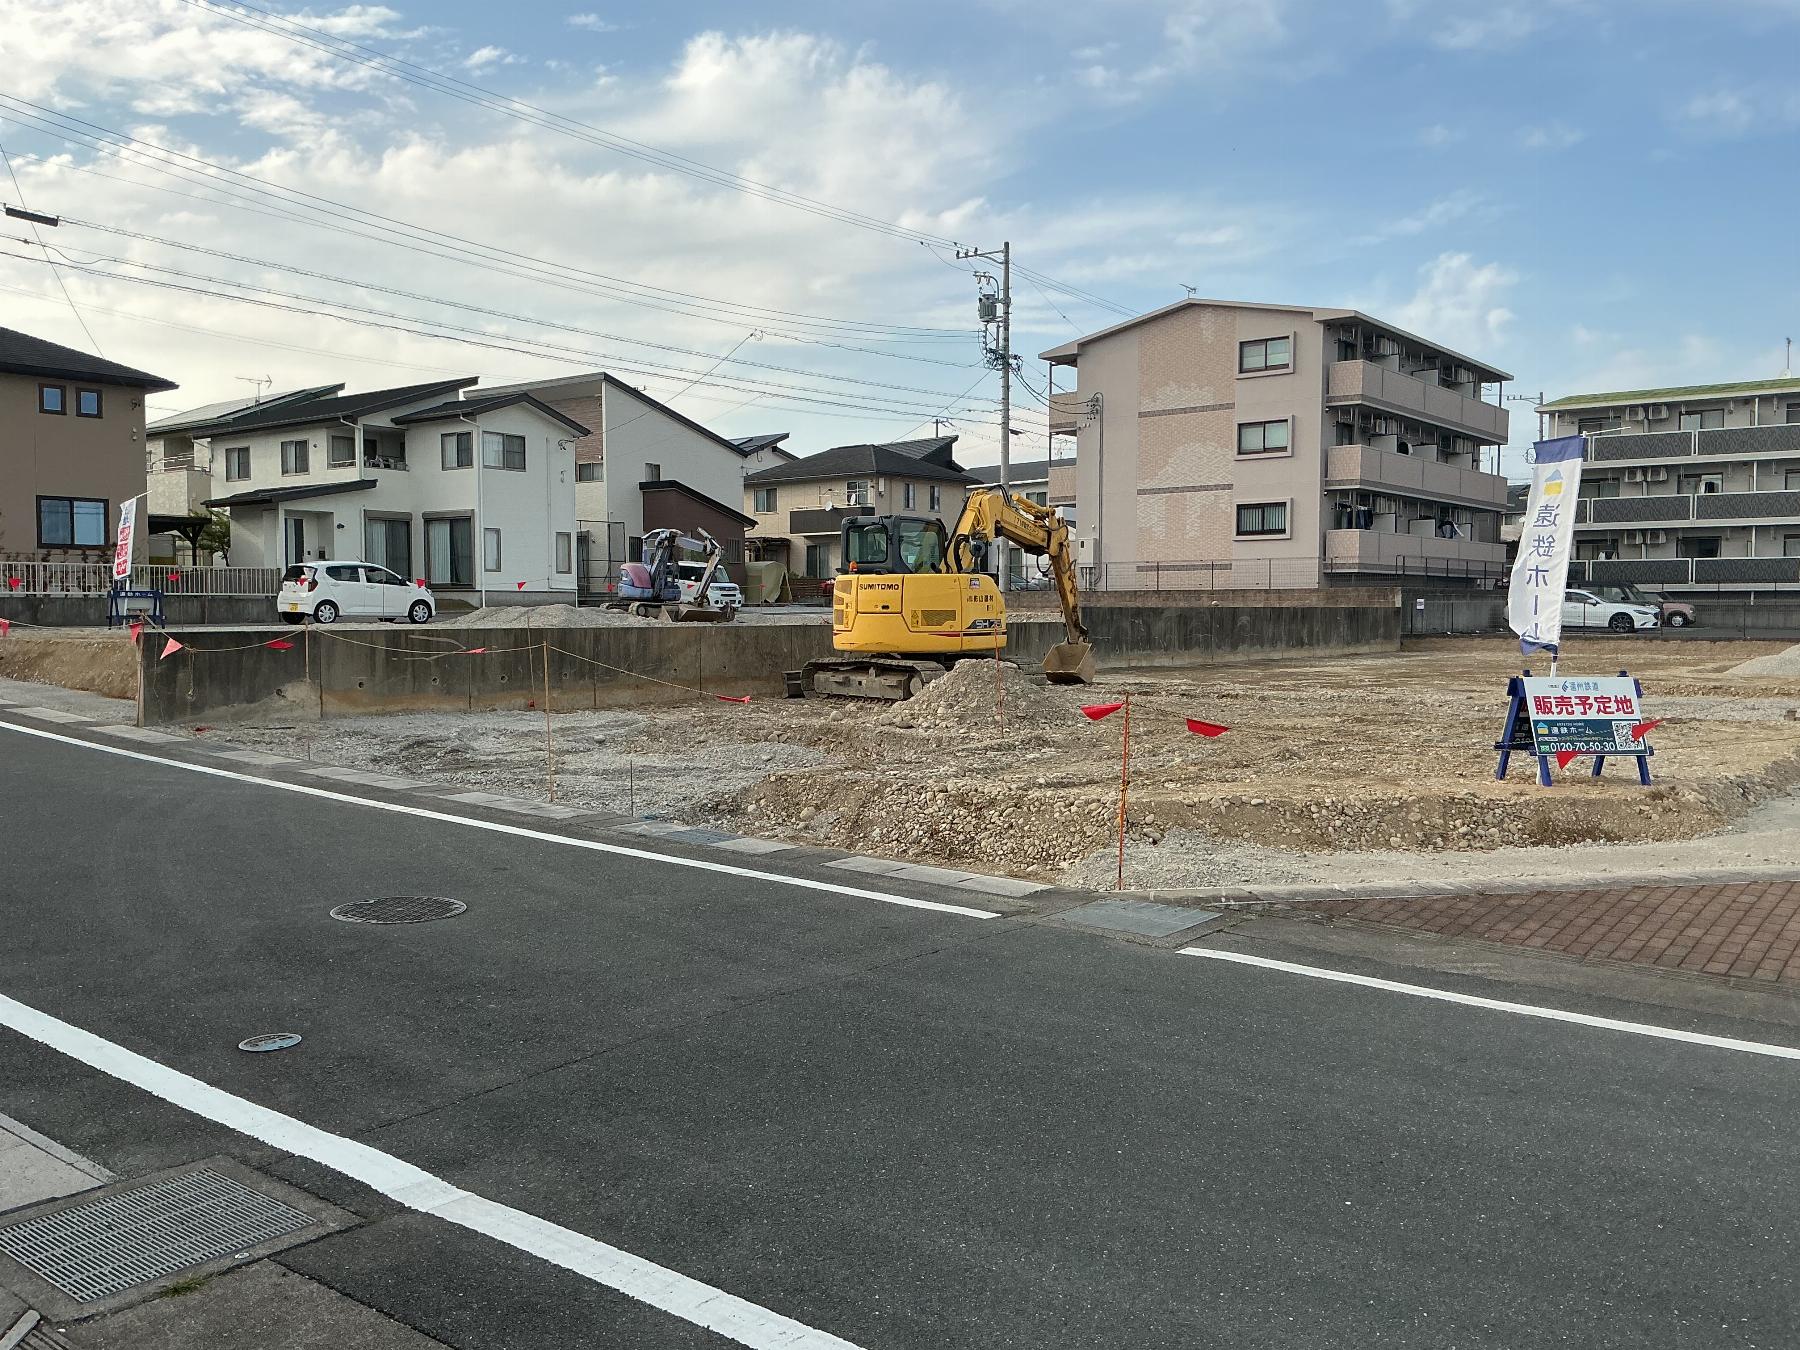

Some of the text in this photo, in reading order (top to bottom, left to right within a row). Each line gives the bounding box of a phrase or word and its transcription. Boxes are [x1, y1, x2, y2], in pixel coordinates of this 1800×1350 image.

[859, 583, 900, 591] SUMITOMO
[1533, 694, 1635, 716] 販売予定地
[1550, 726, 1593, 734] 遠鉄ホーム
[1550, 742, 1616, 752] 0120-70-50-30
